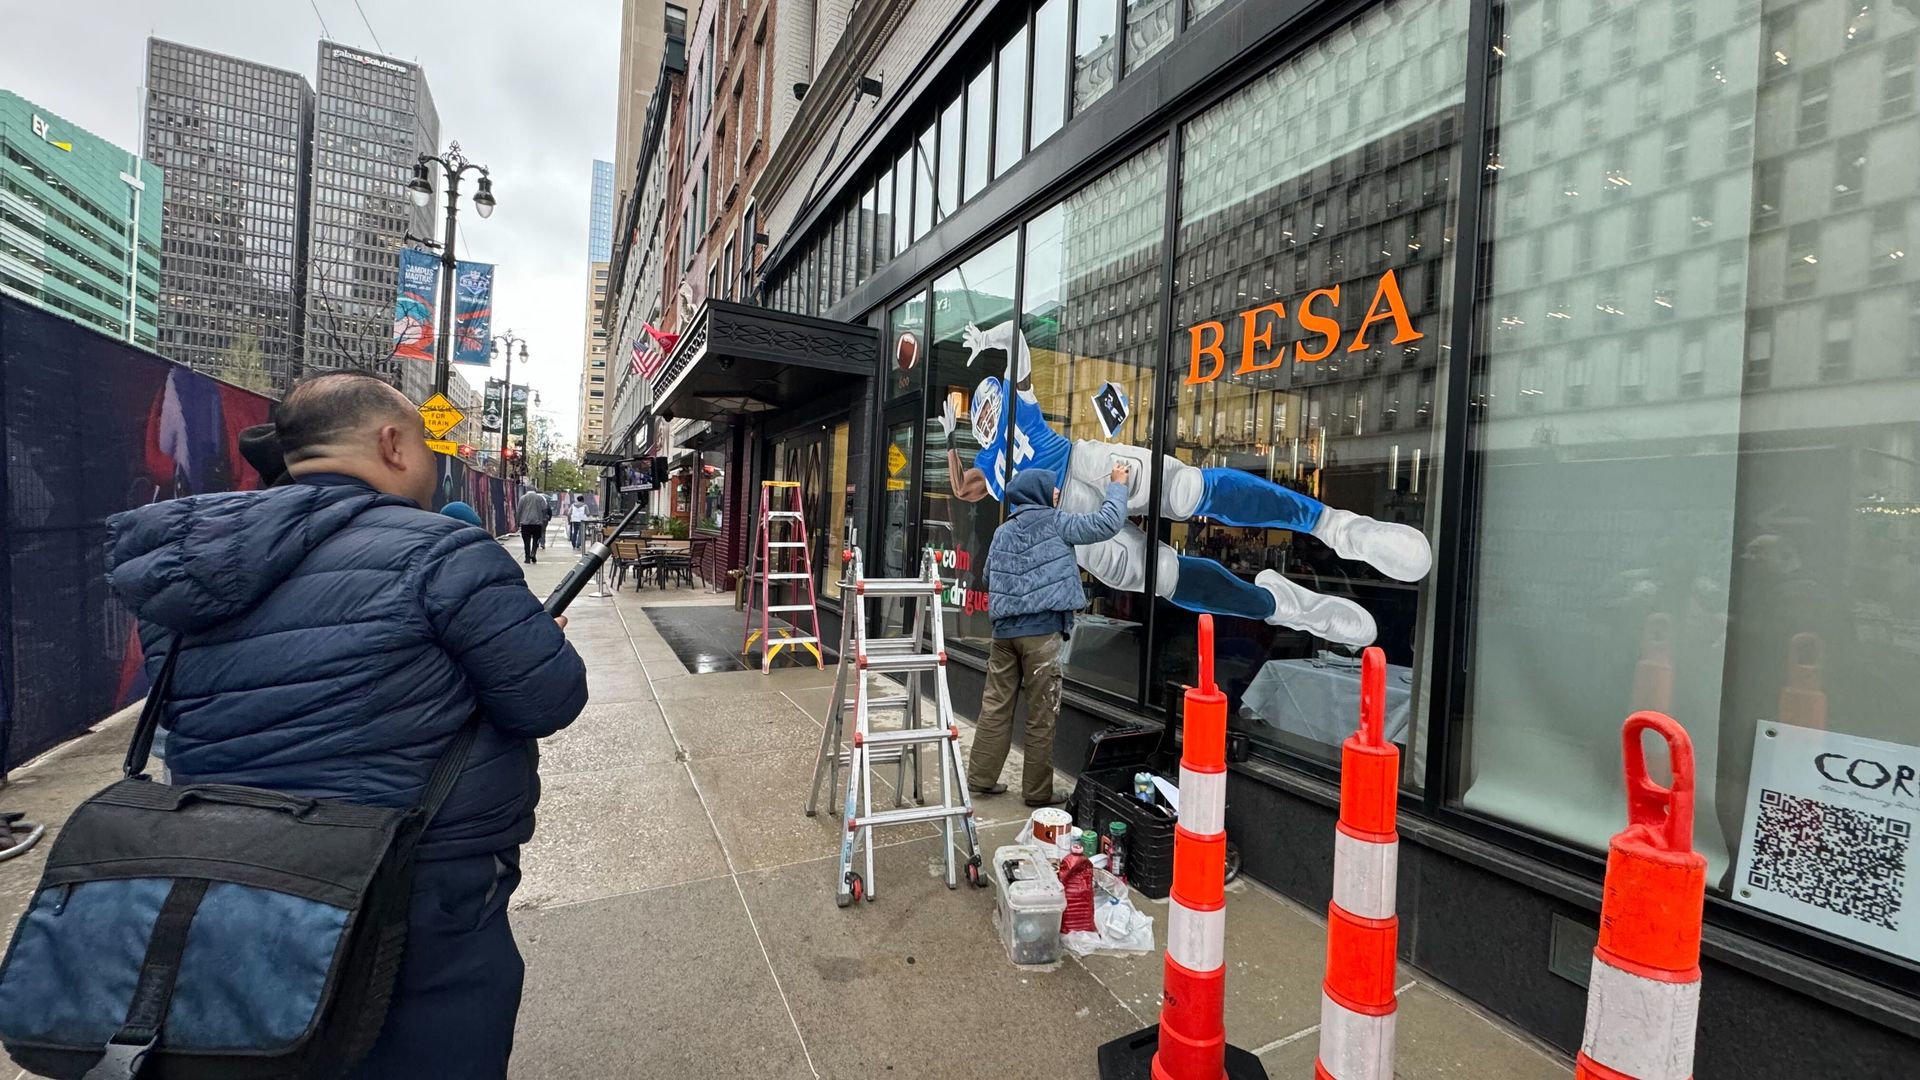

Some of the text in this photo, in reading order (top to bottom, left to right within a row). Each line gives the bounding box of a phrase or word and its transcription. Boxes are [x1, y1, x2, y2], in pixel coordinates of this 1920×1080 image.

[32, 113, 49, 140] EY
[404, 264, 434, 276] CAMPUS
[404, 271, 433, 282] MARTIUS
[1184, 269, 1424, 385] BESA
[428, 419, 449, 427] TRAIN
[941, 578, 990, 616] odrigue
[1814, 752, 1920, 798] COR
